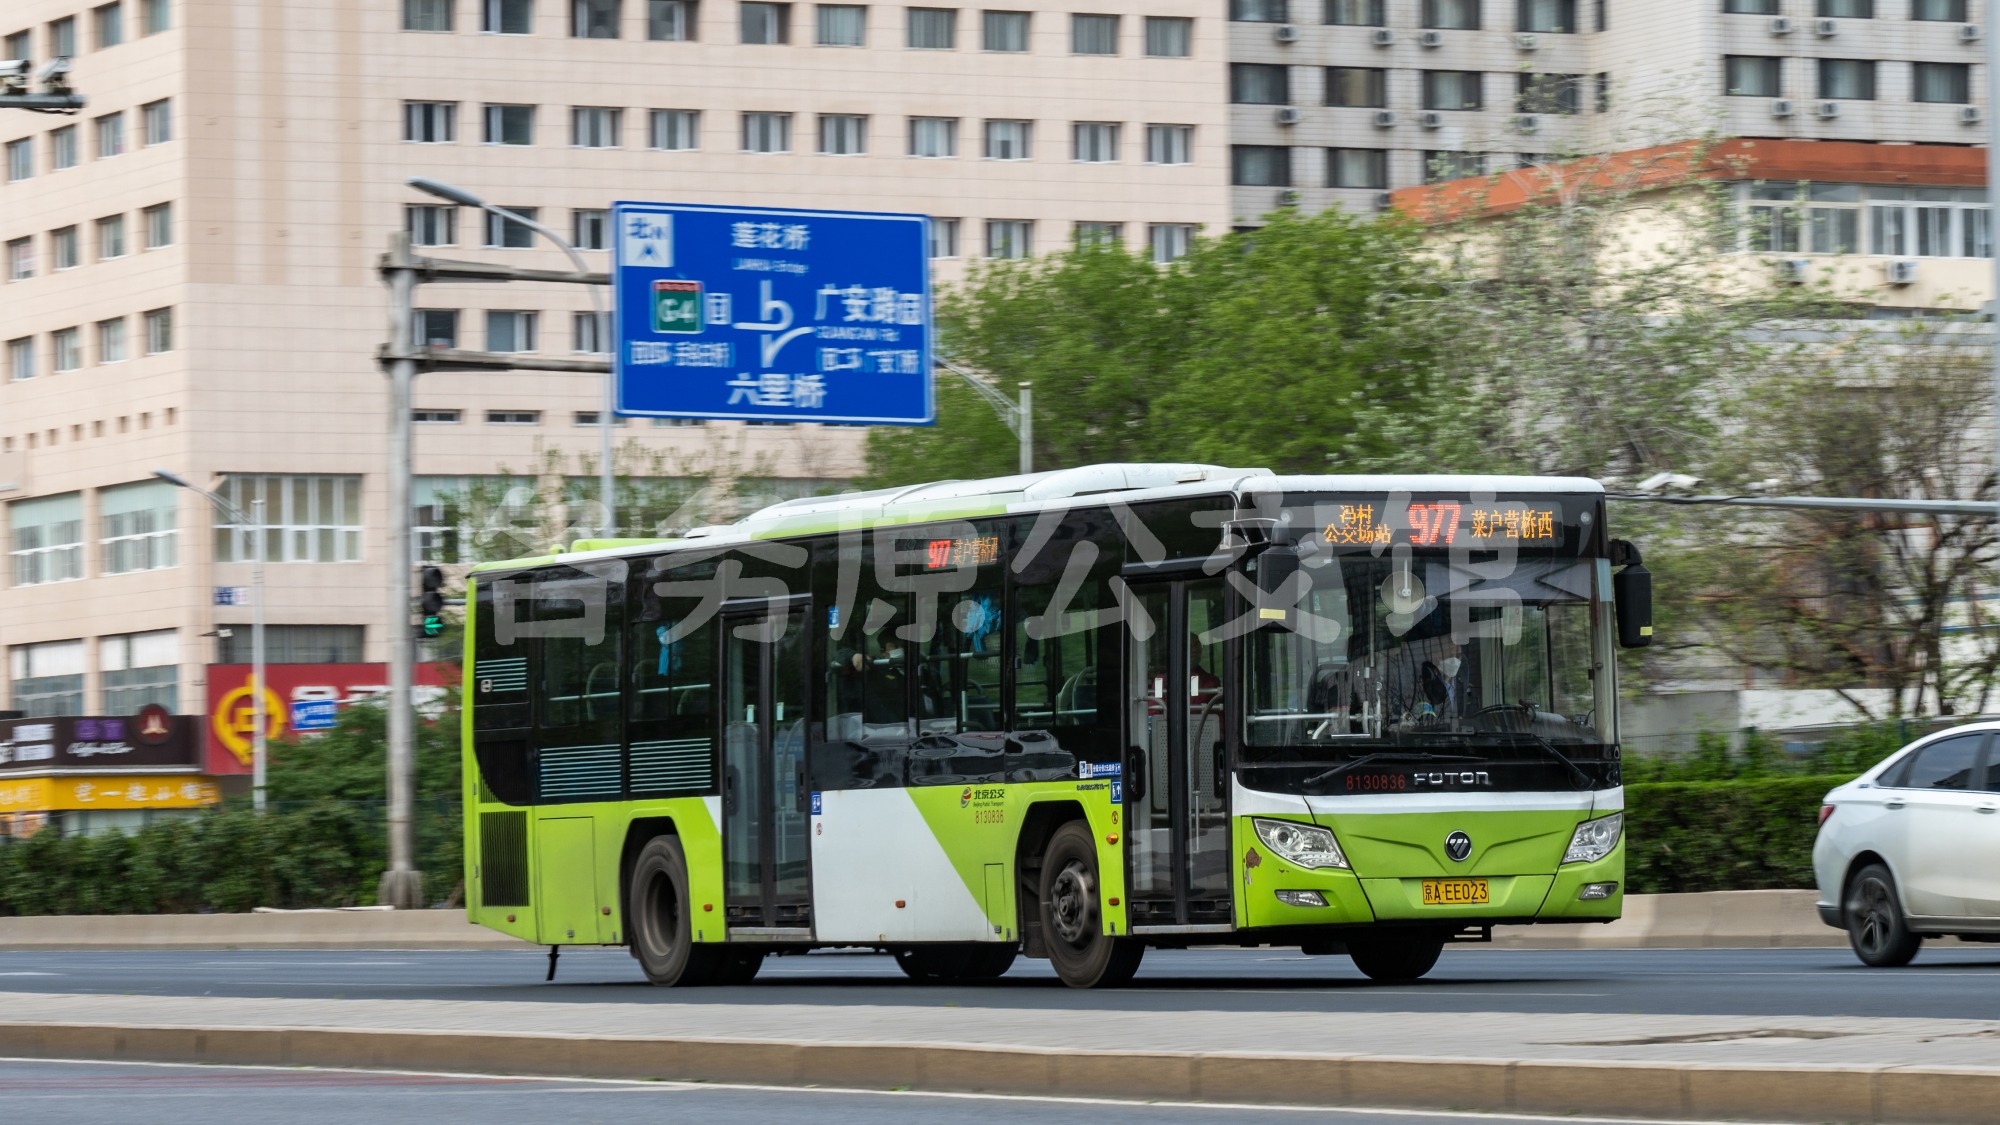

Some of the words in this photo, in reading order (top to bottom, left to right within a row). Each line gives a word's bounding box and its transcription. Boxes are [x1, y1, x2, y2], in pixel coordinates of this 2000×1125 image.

[732, 221, 810, 250] 莲花桥
[658, 298, 697, 323] G4
[726, 372, 827, 408] 六里桥
[1323, 523, 1392, 544] 公交场站
[1409, 504, 1461, 544] 977
[1471, 509, 1553, 539] 菜户营桥西
[928, 540, 950, 568] 977
[1346, 774, 1405, 790] 8130836
[1414, 771, 1489, 785] FOTON
[974, 789, 1004, 799] 北京公交
[976, 809, 1004, 824] 8130836
